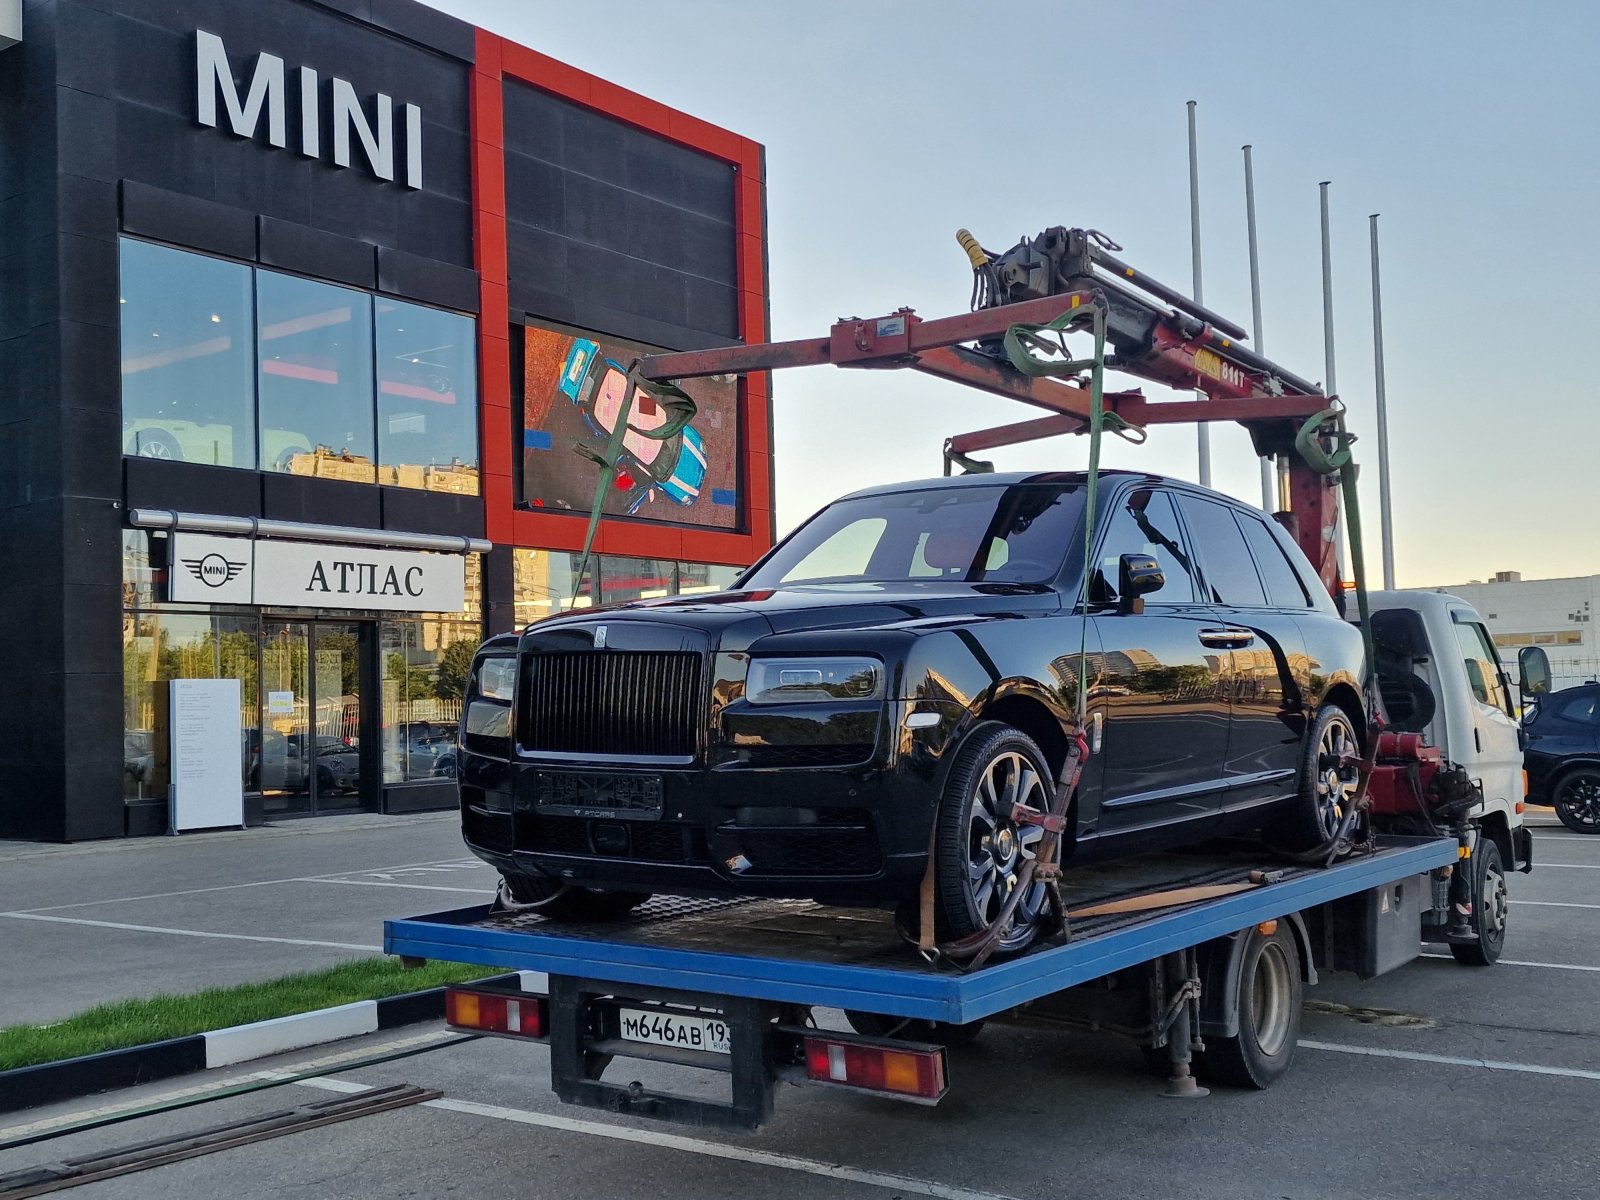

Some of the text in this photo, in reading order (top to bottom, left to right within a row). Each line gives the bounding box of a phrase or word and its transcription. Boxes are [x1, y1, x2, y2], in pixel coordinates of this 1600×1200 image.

[197, 29, 422, 190] MINI
[1222, 362, 1245, 388] 811T
[203, 565, 226, 576] MINI
[305, 560, 424, 597] АТЛАС
